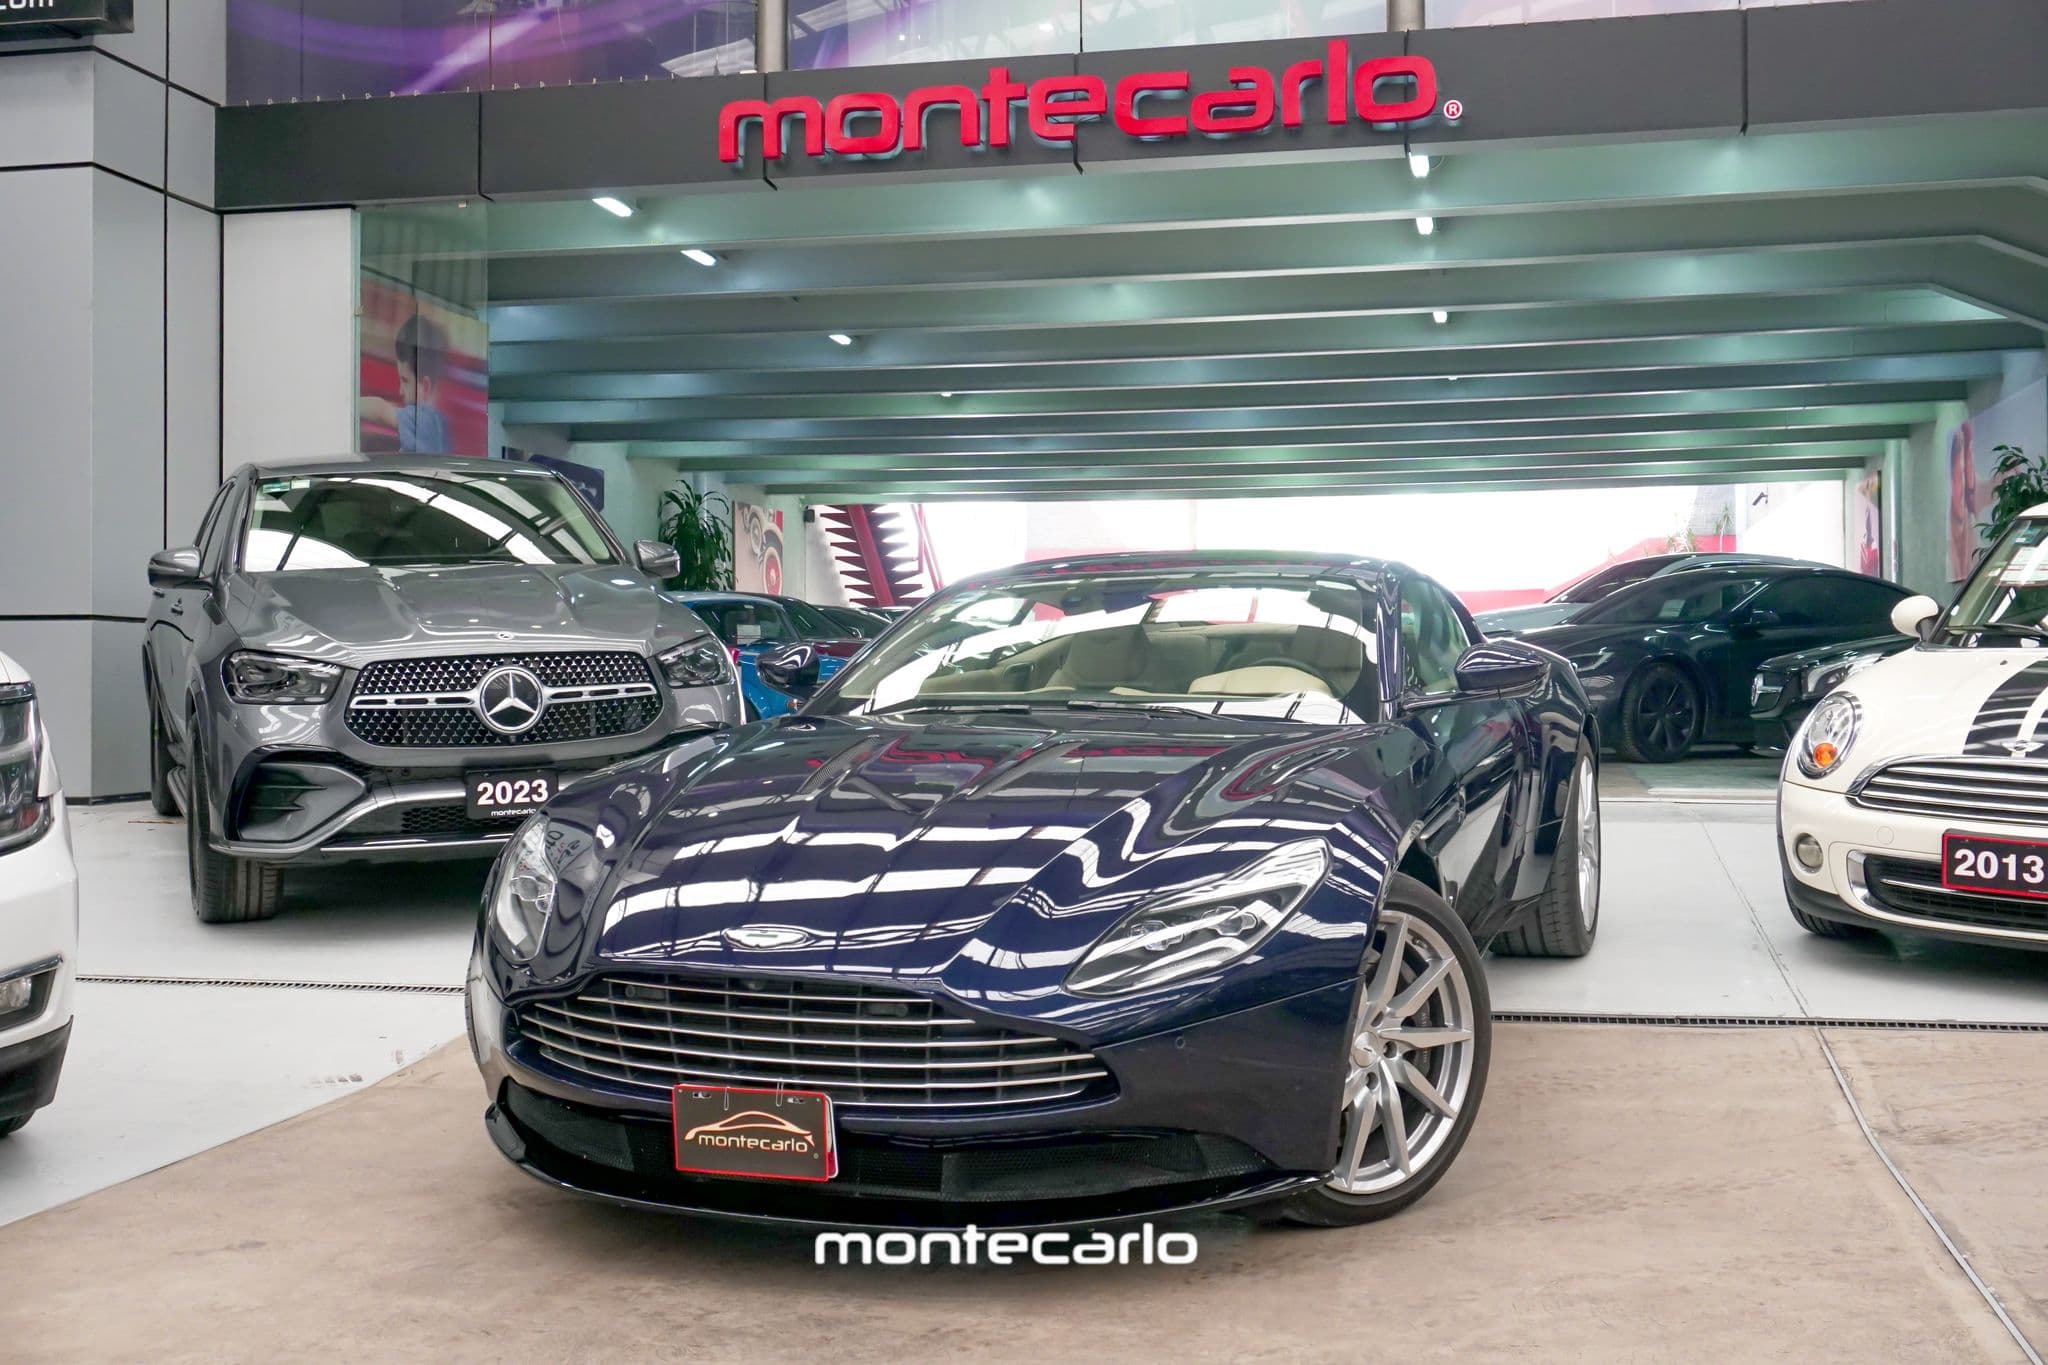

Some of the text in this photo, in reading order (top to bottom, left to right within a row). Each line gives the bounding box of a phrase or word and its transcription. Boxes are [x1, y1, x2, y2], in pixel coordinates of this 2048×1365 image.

[719, 39, 1438, 163] montecarlo
[477, 779, 549, 806] 2023
[1953, 848, 2045, 884] 2013
[698, 1133, 808, 1153] montecarlo
